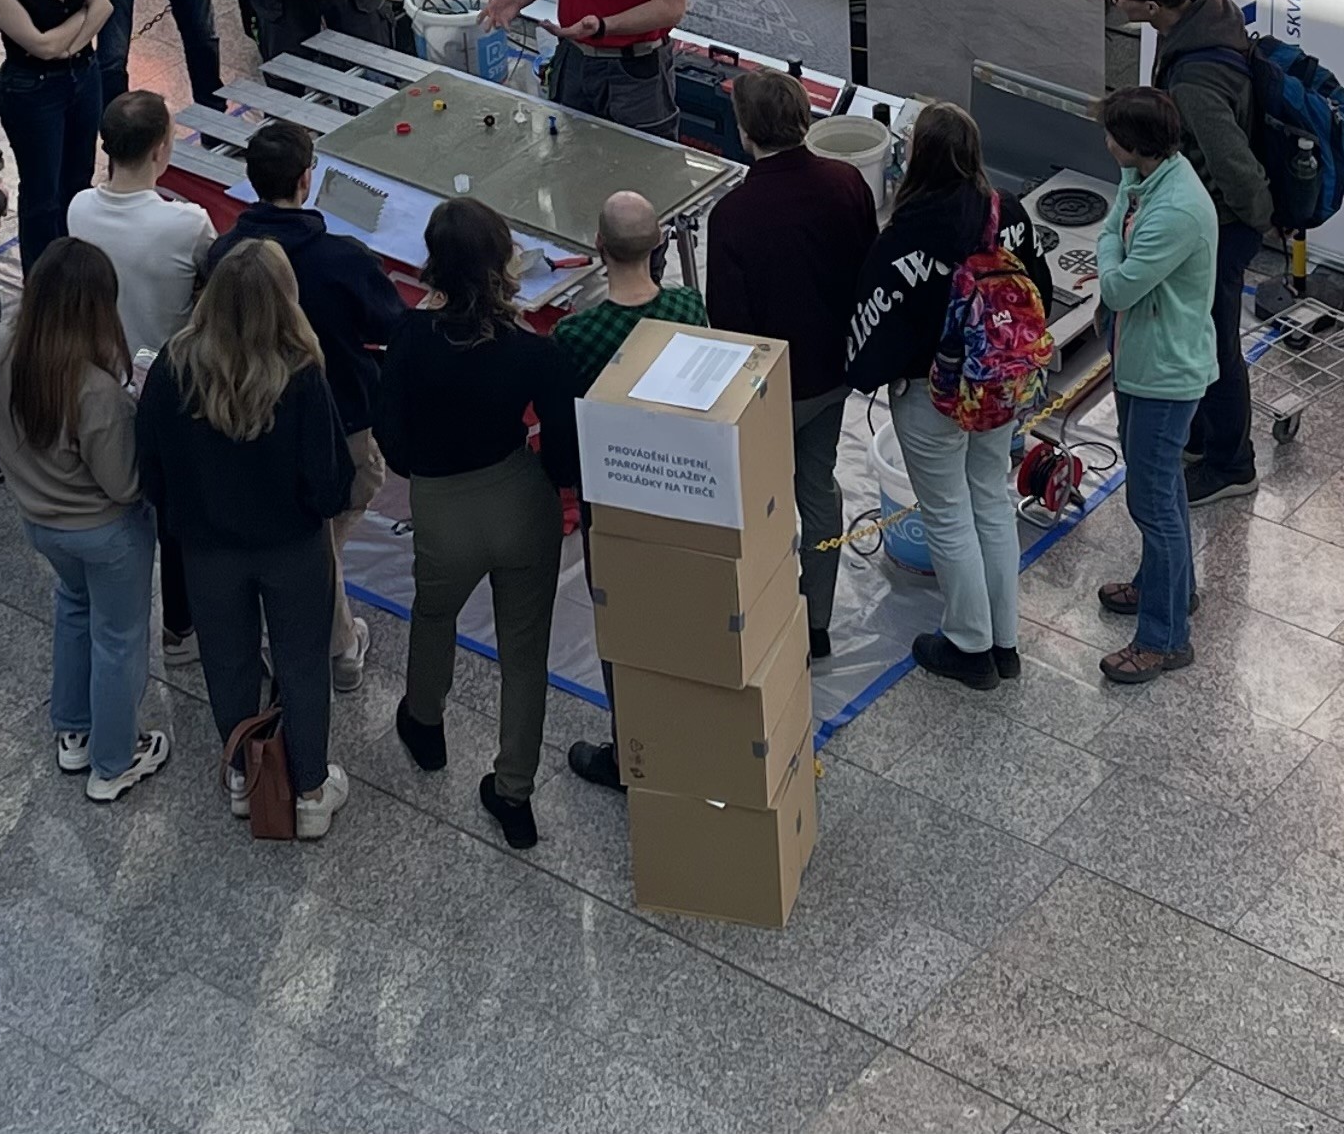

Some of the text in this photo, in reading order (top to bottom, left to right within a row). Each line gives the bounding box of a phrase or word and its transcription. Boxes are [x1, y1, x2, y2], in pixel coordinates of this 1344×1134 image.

[607, 443, 670, 463] PROVÁDĚNÍ
[604, 457, 717, 486] SPAROVÁNÍ DLAŽBY A
[607, 471, 715, 499] POKLÁDKY NA TERČE
